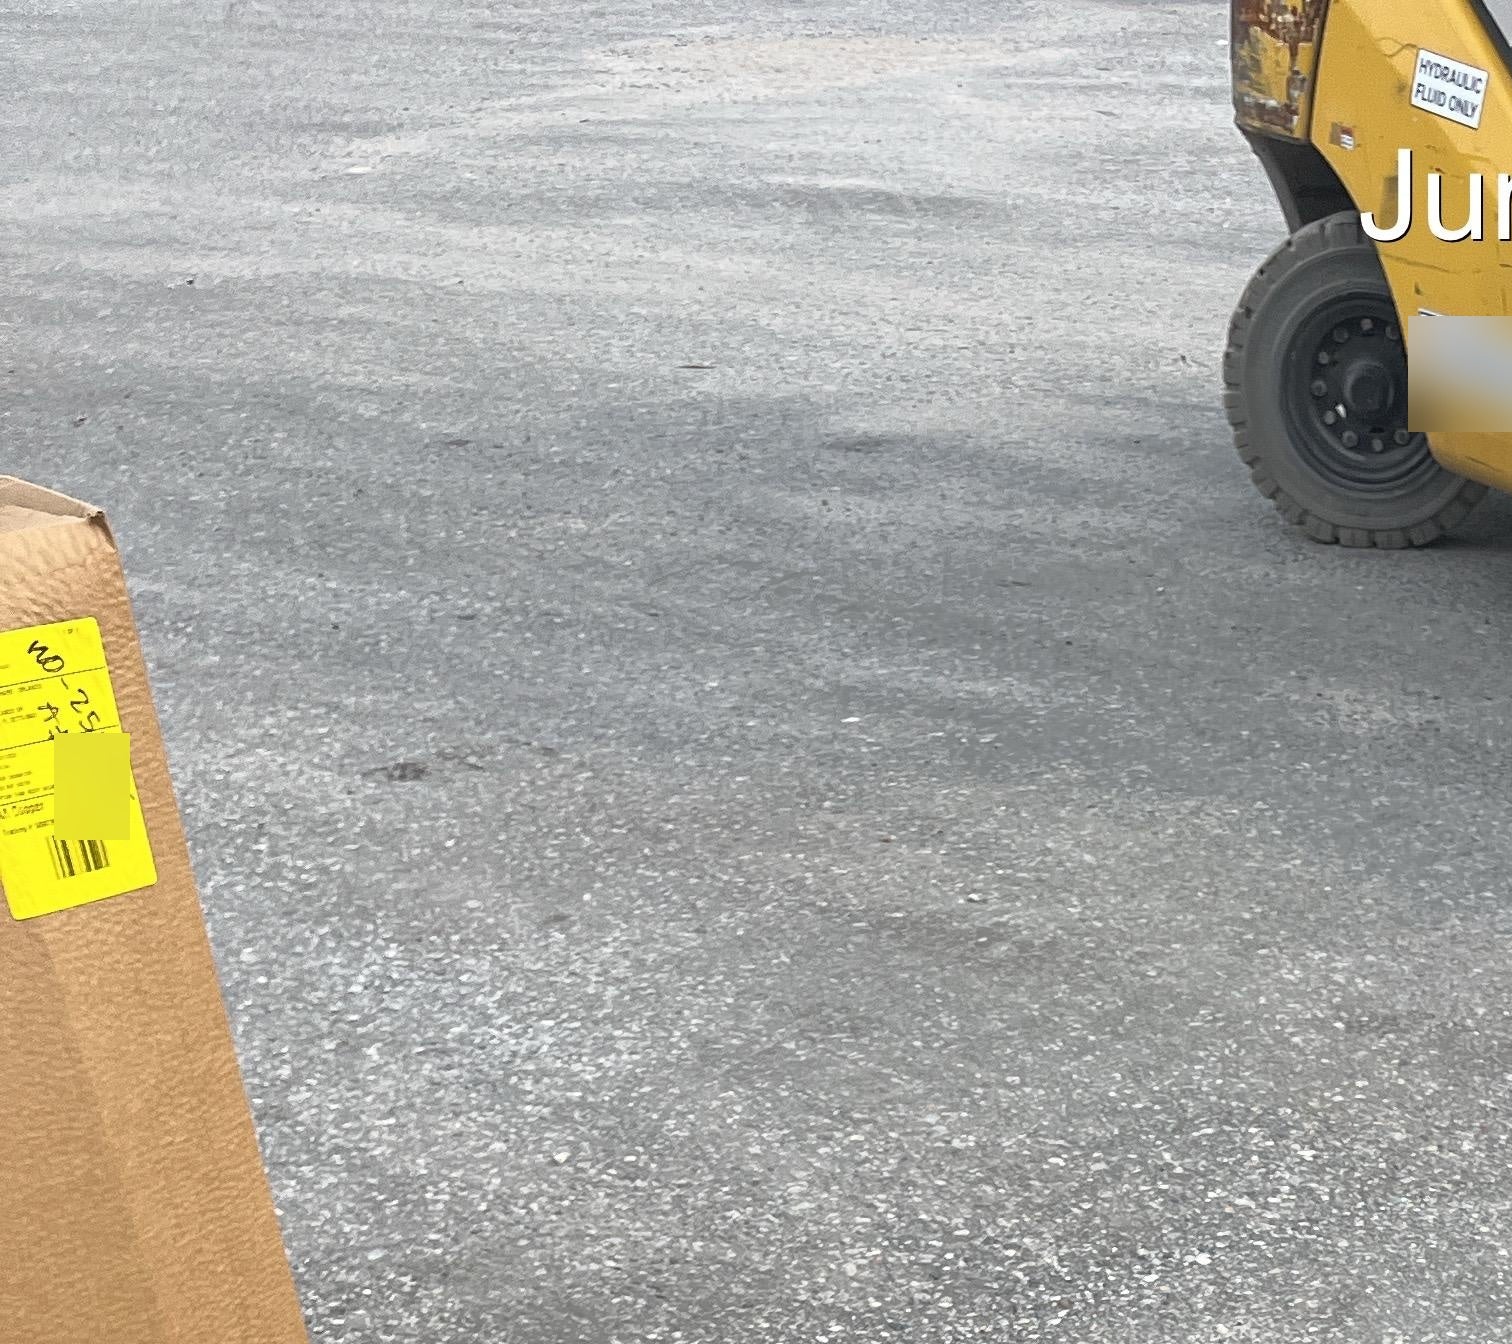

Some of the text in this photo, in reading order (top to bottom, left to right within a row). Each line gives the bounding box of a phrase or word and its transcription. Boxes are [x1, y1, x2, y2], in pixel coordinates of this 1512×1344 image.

[1419, 58, 1482, 94] HYDRAULIC
[1415, 83, 1479, 118] FLUID ONLY
